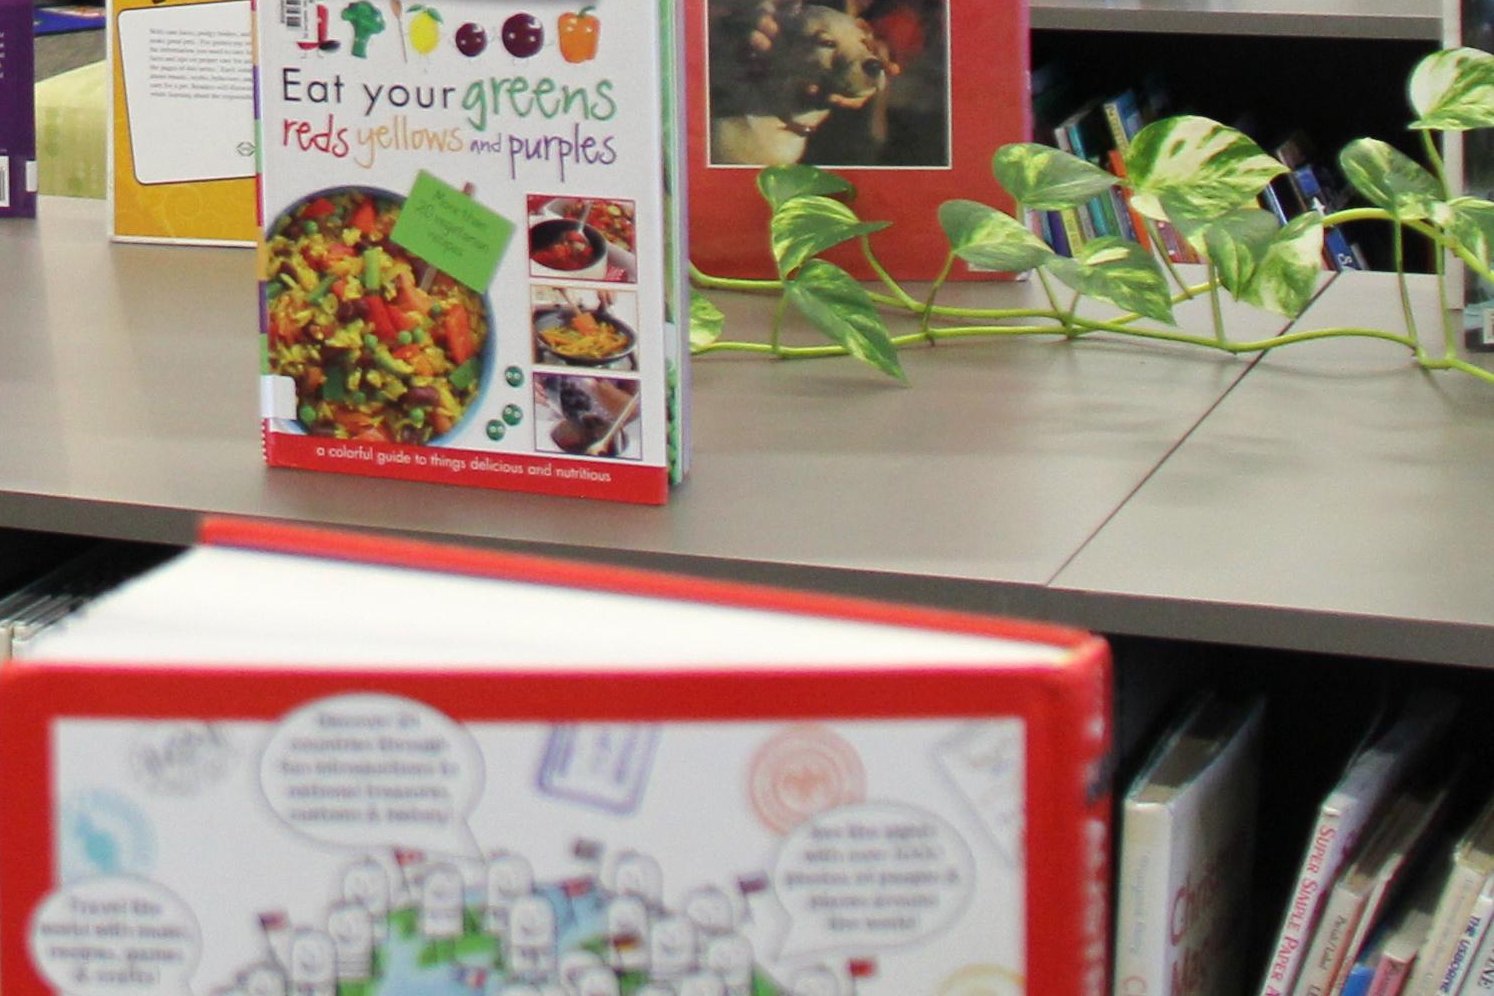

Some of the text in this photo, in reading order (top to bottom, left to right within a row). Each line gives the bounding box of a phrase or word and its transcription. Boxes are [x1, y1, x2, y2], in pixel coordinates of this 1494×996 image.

[281, 67, 618, 132] Eat your greens
[282, 113, 618, 183] reds yellows and purples
[316, 444, 612, 483] a colorful guide to things delicious and nutritious
[1270, 826, 1336, 982] SUPER SIMPLE PAPER
